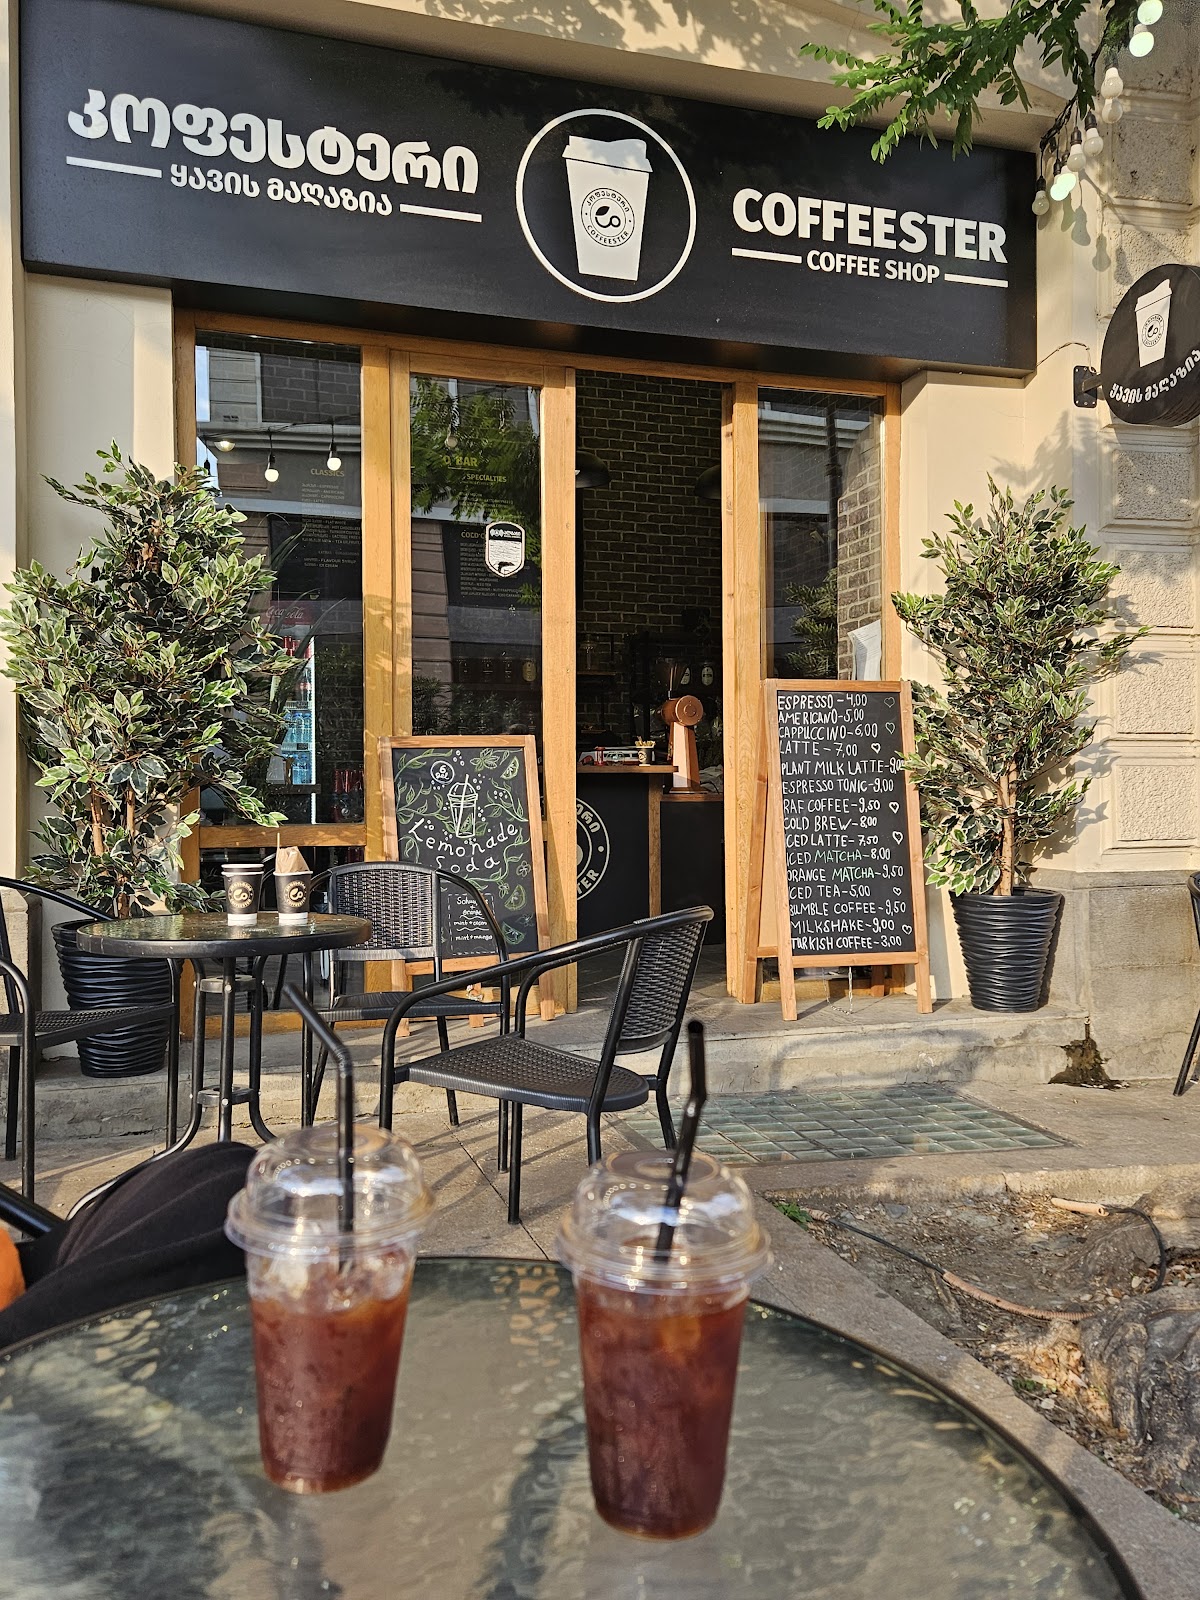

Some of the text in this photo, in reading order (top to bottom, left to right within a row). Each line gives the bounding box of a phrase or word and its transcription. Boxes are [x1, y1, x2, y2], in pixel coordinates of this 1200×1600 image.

[66, 88, 479, 195] კოფესტერი
[170, 163, 393, 216] ყავის მაღაზია
[732, 188, 1008, 264] COFFEESTER
[806, 249, 941, 284] COFFEE SHOP
[778, 693, 833, 710] ESPRESSO
[779, 740, 820, 756] LATTE
[781, 760, 811, 776] PLANT
[814, 761, 844, 776] MILK
[782, 779, 834, 795] ESPRESSO
[783, 799, 804, 814] RAF
[784, 816, 810, 830] COLD
[786, 834, 808, 848] CED
[791, 935, 833, 950] TURKISH
